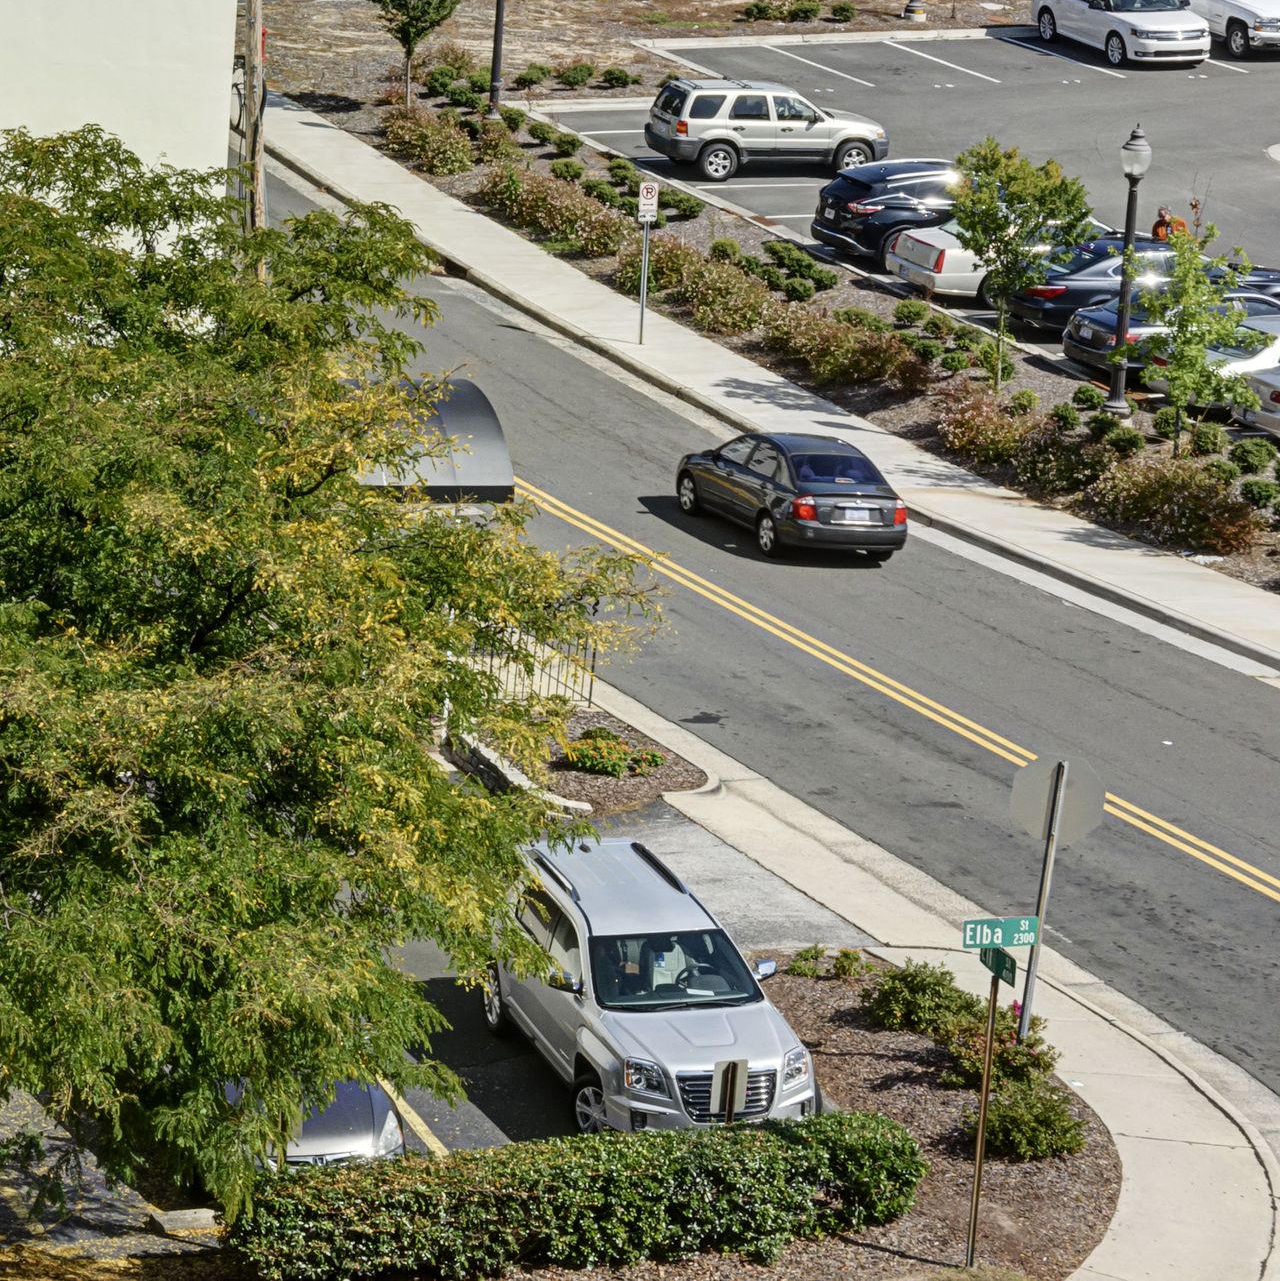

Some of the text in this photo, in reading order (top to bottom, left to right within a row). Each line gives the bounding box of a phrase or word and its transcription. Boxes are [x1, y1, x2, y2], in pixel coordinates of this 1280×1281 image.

[965, 919, 1029, 945] Elba St
[1013, 932, 1035, 945] 2300
